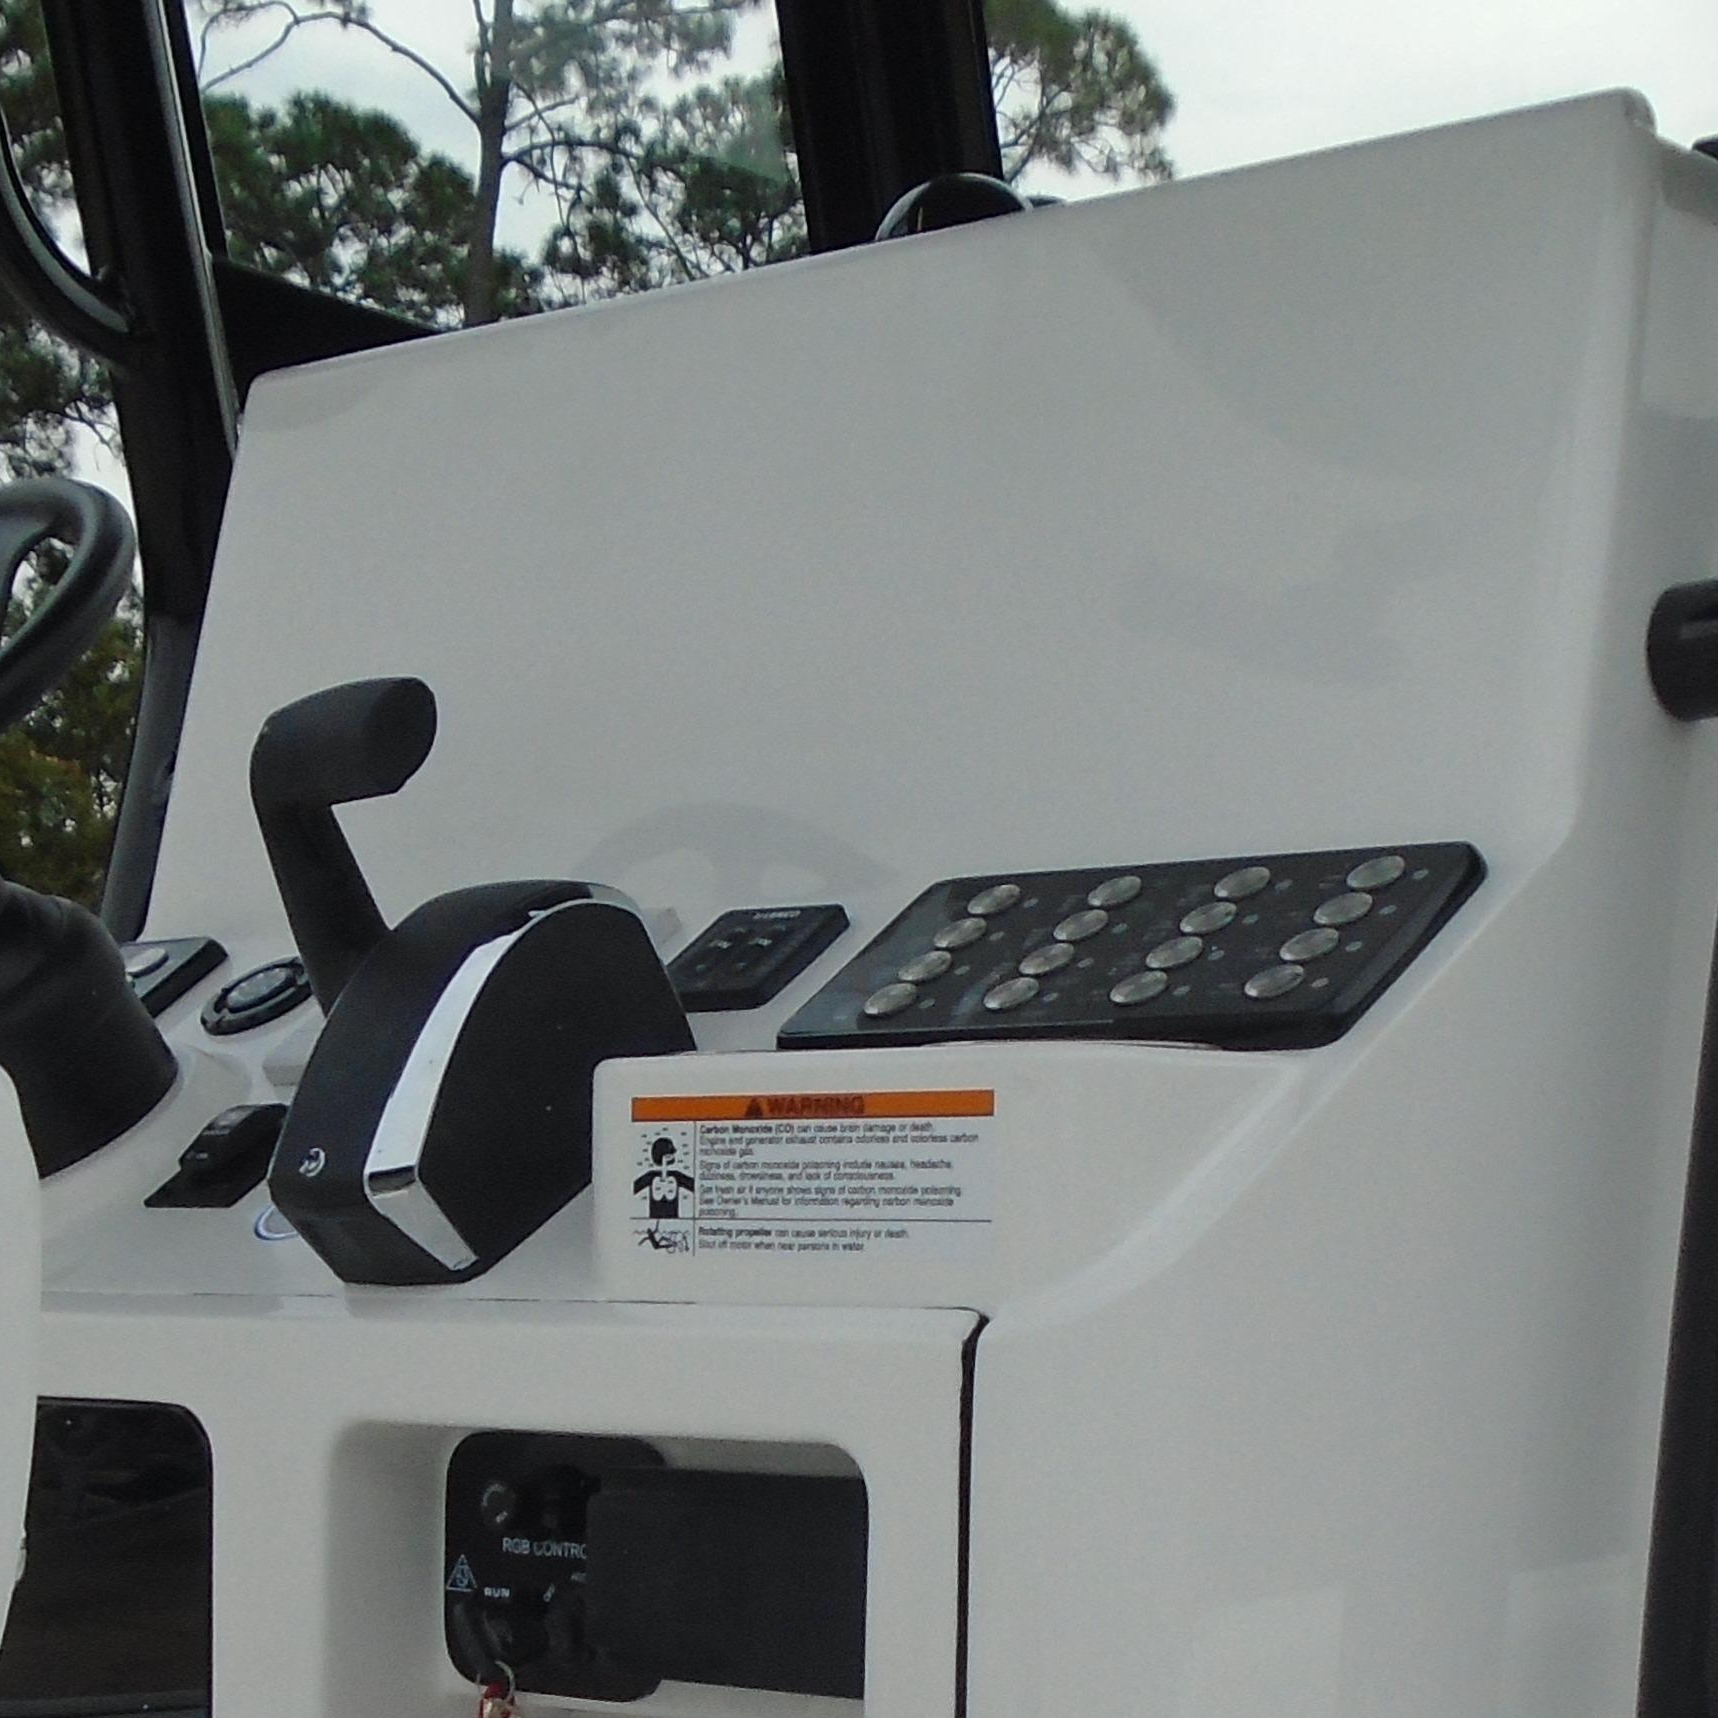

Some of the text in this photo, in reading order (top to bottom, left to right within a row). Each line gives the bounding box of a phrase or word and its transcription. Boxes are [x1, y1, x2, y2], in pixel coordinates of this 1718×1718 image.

[767, 1095, 865, 1116] WARNING
[502, 1537, 531, 1554] RGB
[483, 1586, 511, 1598] RUN
